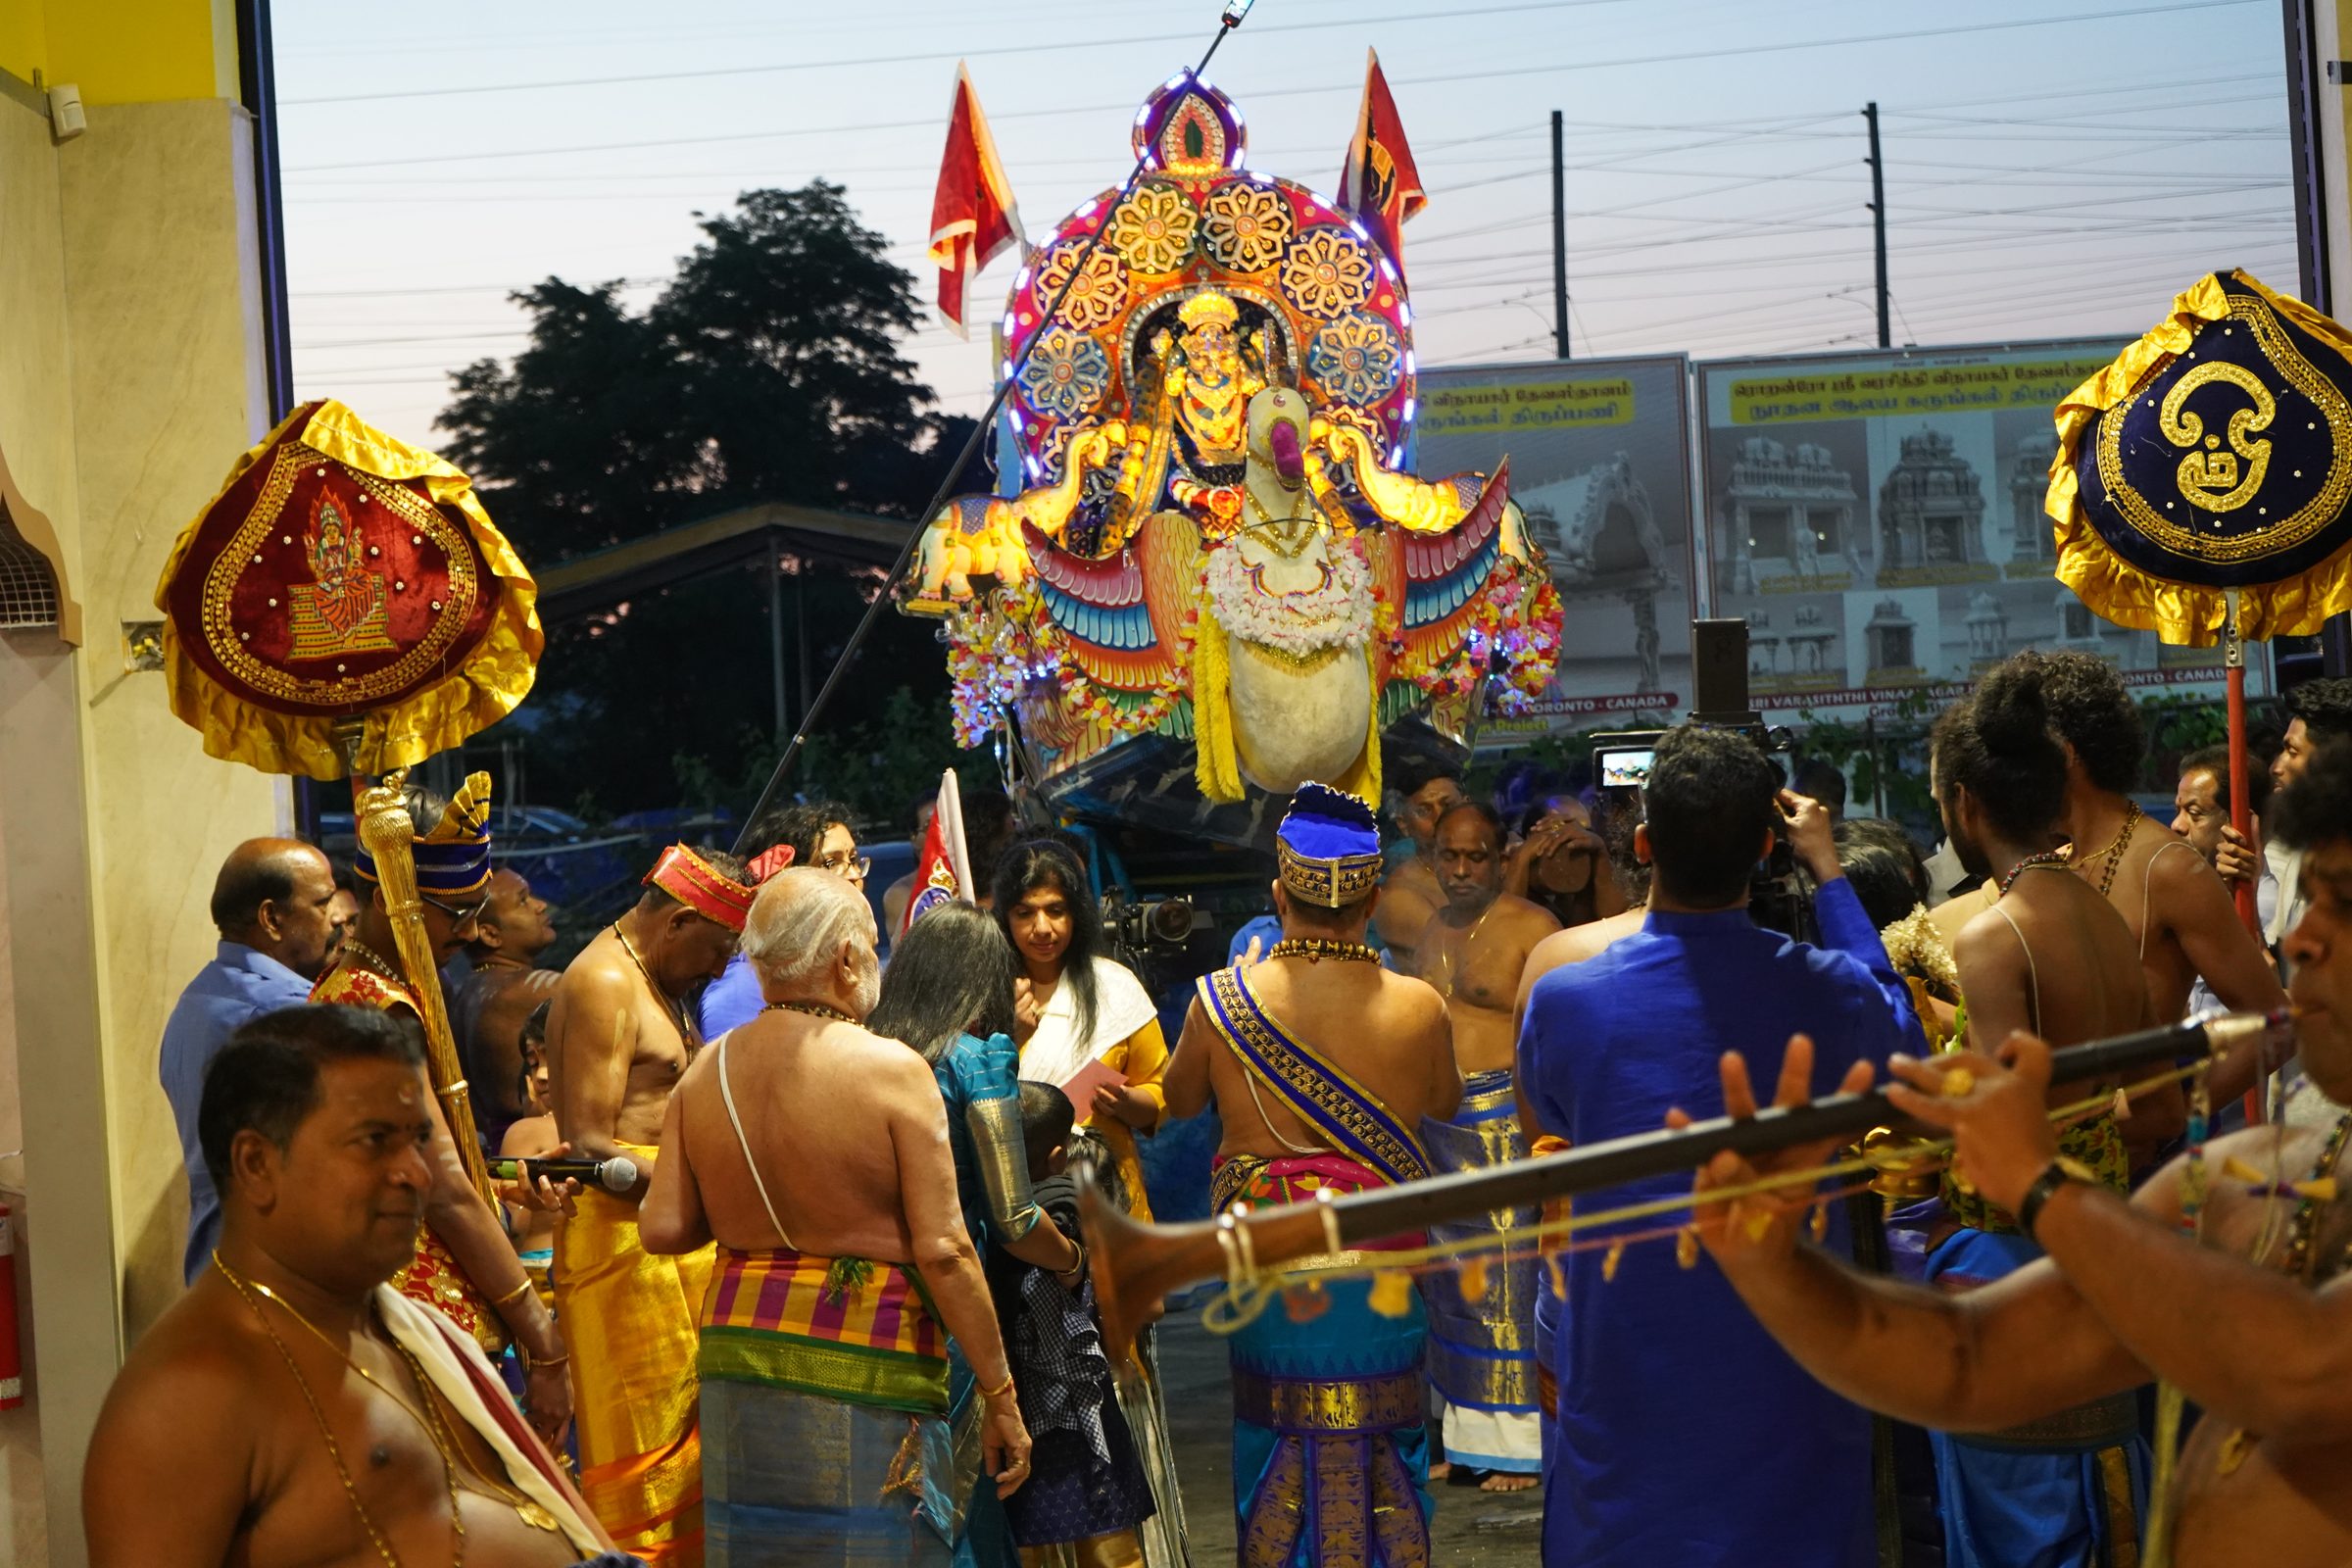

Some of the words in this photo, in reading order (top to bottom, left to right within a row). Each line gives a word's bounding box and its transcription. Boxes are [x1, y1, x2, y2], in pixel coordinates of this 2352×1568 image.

[2175, 667, 2225, 682] CANAD
[1532, 699, 1593, 713] ORONTO
[1606, 695, 1668, 710] CANADA
